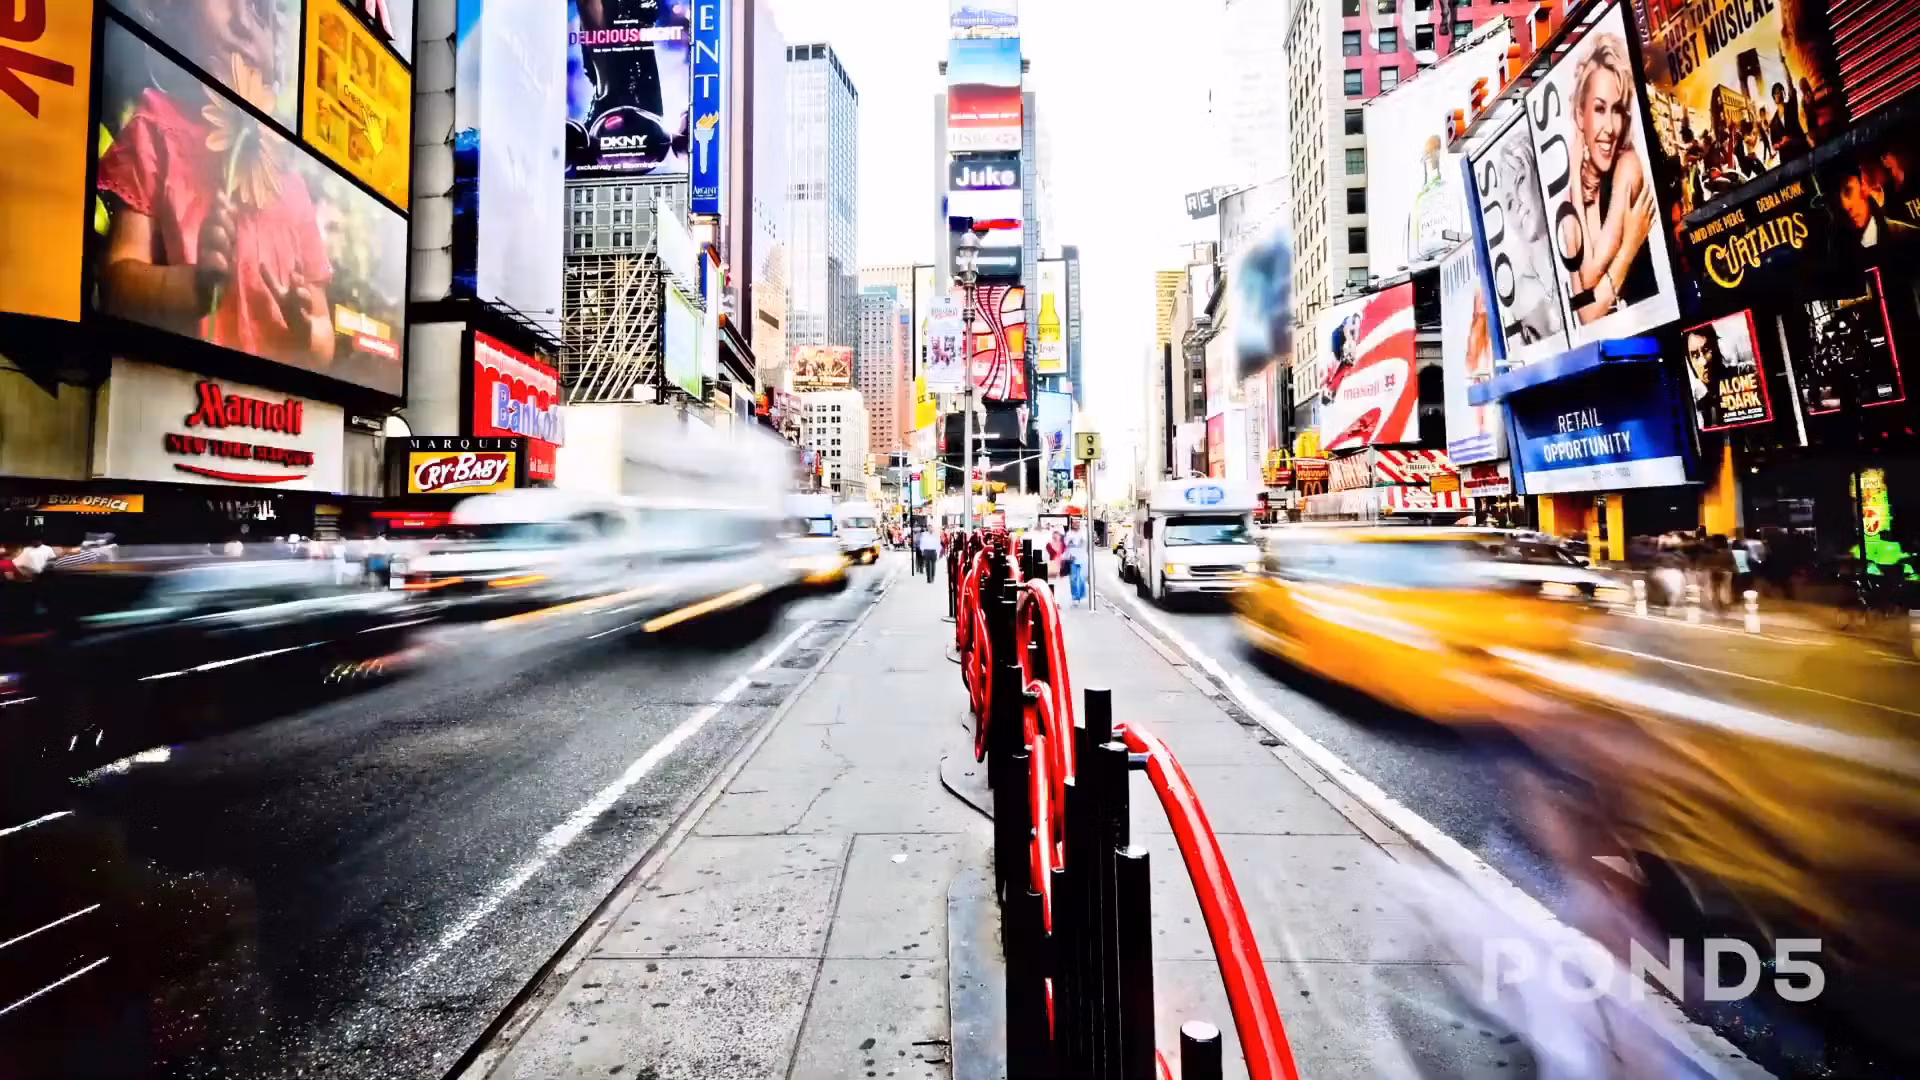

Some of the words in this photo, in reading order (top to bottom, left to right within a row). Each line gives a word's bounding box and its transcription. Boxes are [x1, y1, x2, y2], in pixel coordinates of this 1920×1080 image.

[1668, 32, 1700, 87] BEST
[601, 135, 648, 147] DKNY
[1719, 373, 1758, 396] ALONE
[185, 378, 303, 436] Marriott
[492, 381, 540, 439] Bank
[1727, 391, 1762, 410] DARK
[1558, 408, 1603, 433] RETAIL
[409, 438, 519, 449] MARQUIS
[1544, 431, 1631, 463] OPPORTUNITY
[47, 494, 77, 505] BOX
[81, 495, 129, 511] OFFICE
